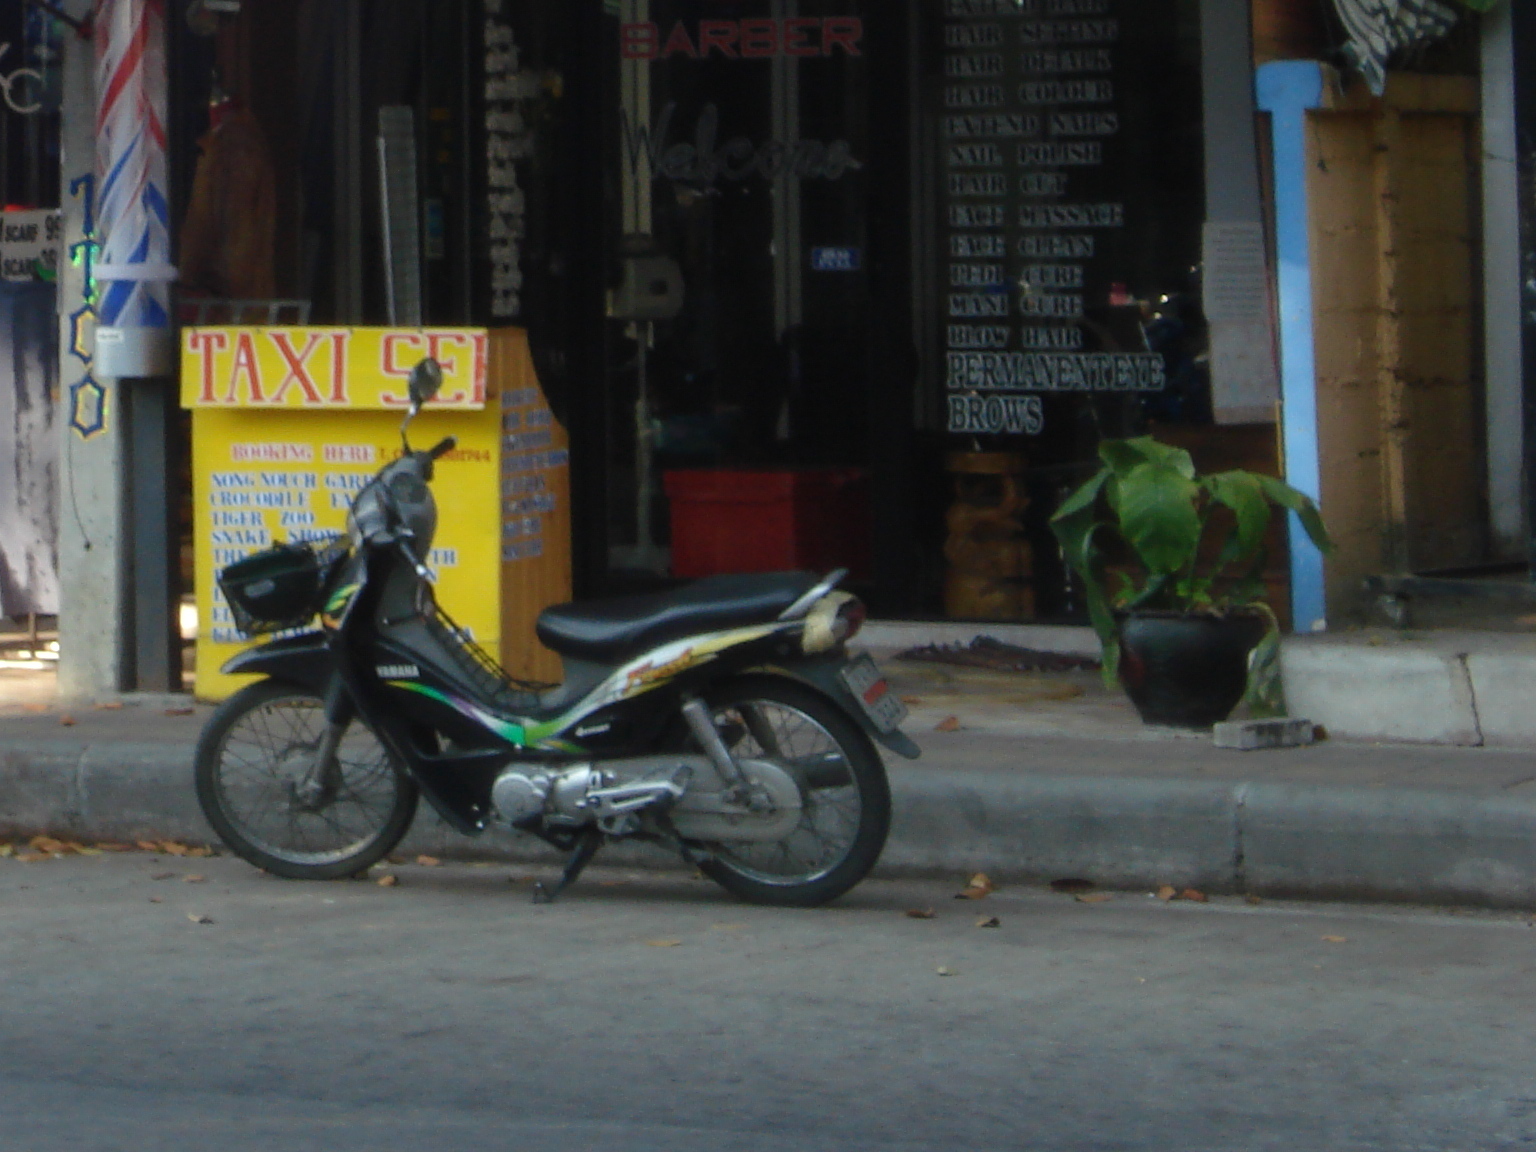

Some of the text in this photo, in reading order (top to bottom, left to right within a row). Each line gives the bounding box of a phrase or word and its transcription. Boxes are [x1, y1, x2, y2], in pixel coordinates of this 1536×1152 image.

[620, 15, 864, 60] BARBER
[944, 22, 1004, 46] HAIR
[944, 53, 1005, 77] HAIR
[944, 84, 1005, 107] HAIR
[945, 114, 1040, 136] EXTEND
[948, 141, 1103, 166] NAIL POLISH
[948, 171, 1070, 196] HAIR CUT
[948, 203, 1125, 227] FACE MASSAGE
[949, 234, 1096, 257] FACE CLEAN
[949, 262, 1085, 288] PEDI CURE
[948, 292, 1085, 317] MANI CURE
[946, 324, 1084, 349] BLOW HAIR
[188, 332, 352, 405] TAXI
[947, 394, 1045, 435] BROWS
[231, 444, 314, 463] BOOKING
[323, 445, 376, 463] HERE
[211, 473, 255, 489] NONG
[260, 473, 317, 489] NOUCH
[210, 491, 309, 509] CROCODILE
[212, 510, 316, 528] TIGER ZOO
[212, 529, 270, 546] SNAKE
[375, 663, 421, 679] YAMAHA
